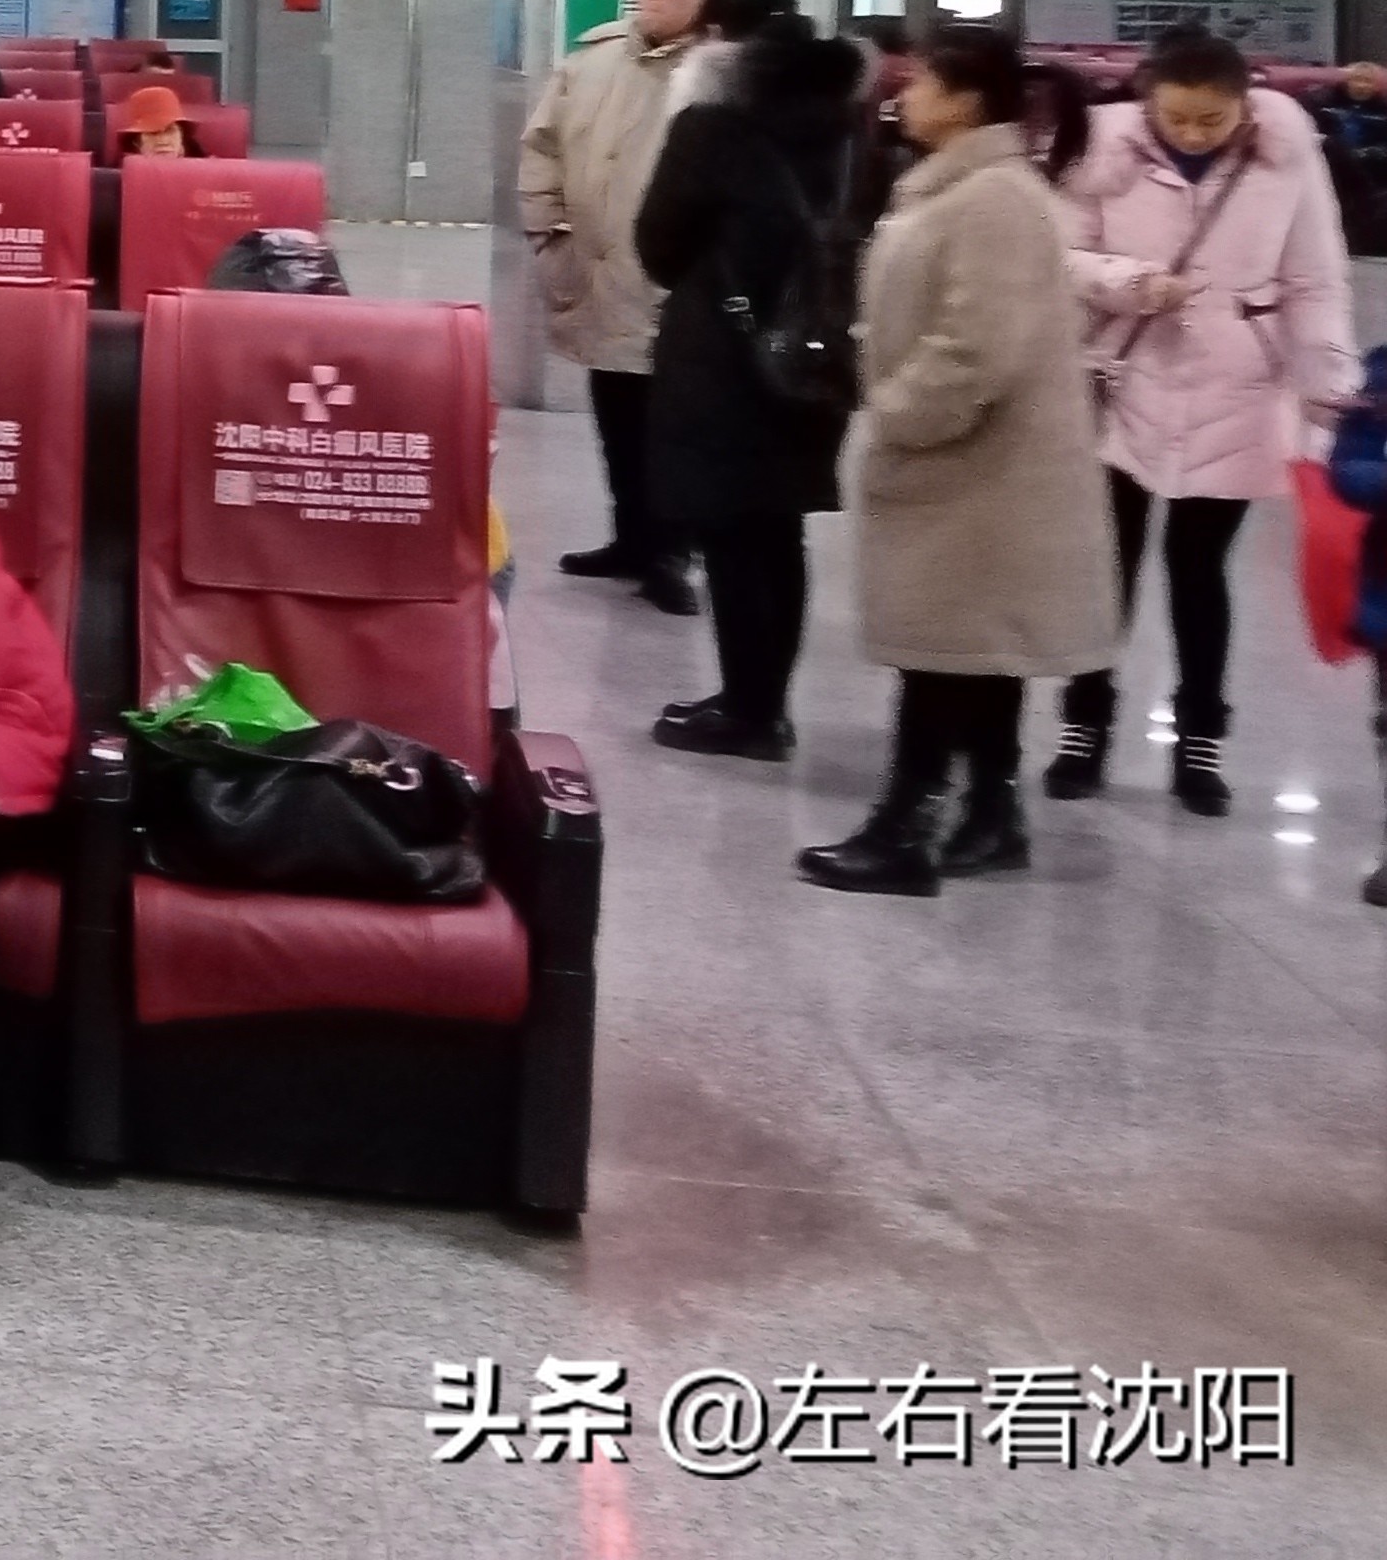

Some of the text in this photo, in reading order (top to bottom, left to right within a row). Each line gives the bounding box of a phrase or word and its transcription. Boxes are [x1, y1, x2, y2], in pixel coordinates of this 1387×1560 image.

[213, 421, 433, 460] 沈阳中科白癜风医院
